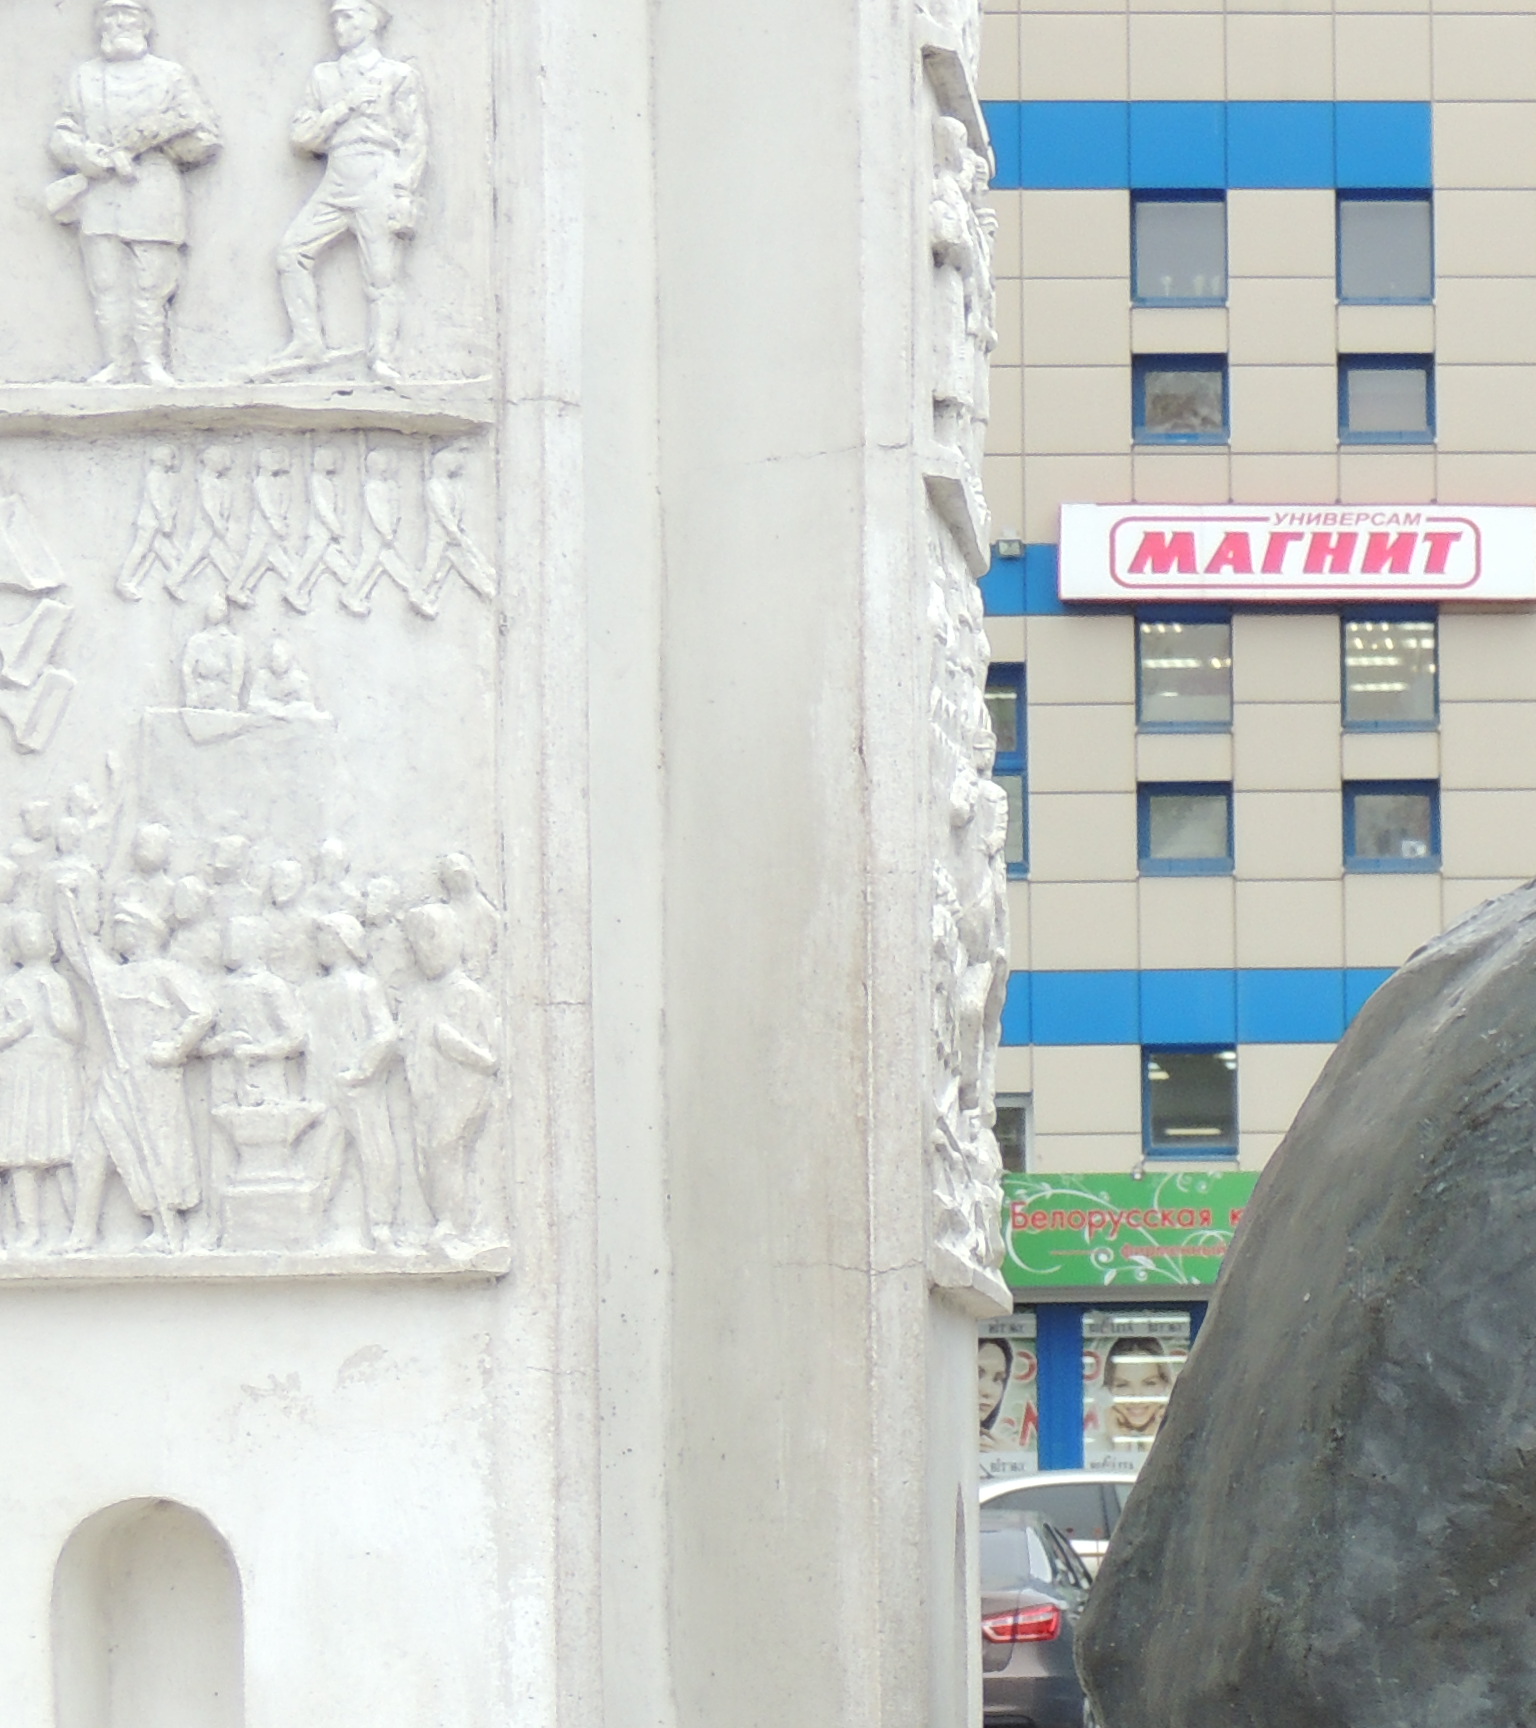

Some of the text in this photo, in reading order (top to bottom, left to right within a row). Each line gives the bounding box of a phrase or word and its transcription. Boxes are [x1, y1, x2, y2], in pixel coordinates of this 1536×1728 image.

[1271, 511, 1422, 527] УНИВЕРСАМ
[1127, 530, 1465, 575] МАГНИТ
[1010, 1201, 1213, 1239] Белорусская
